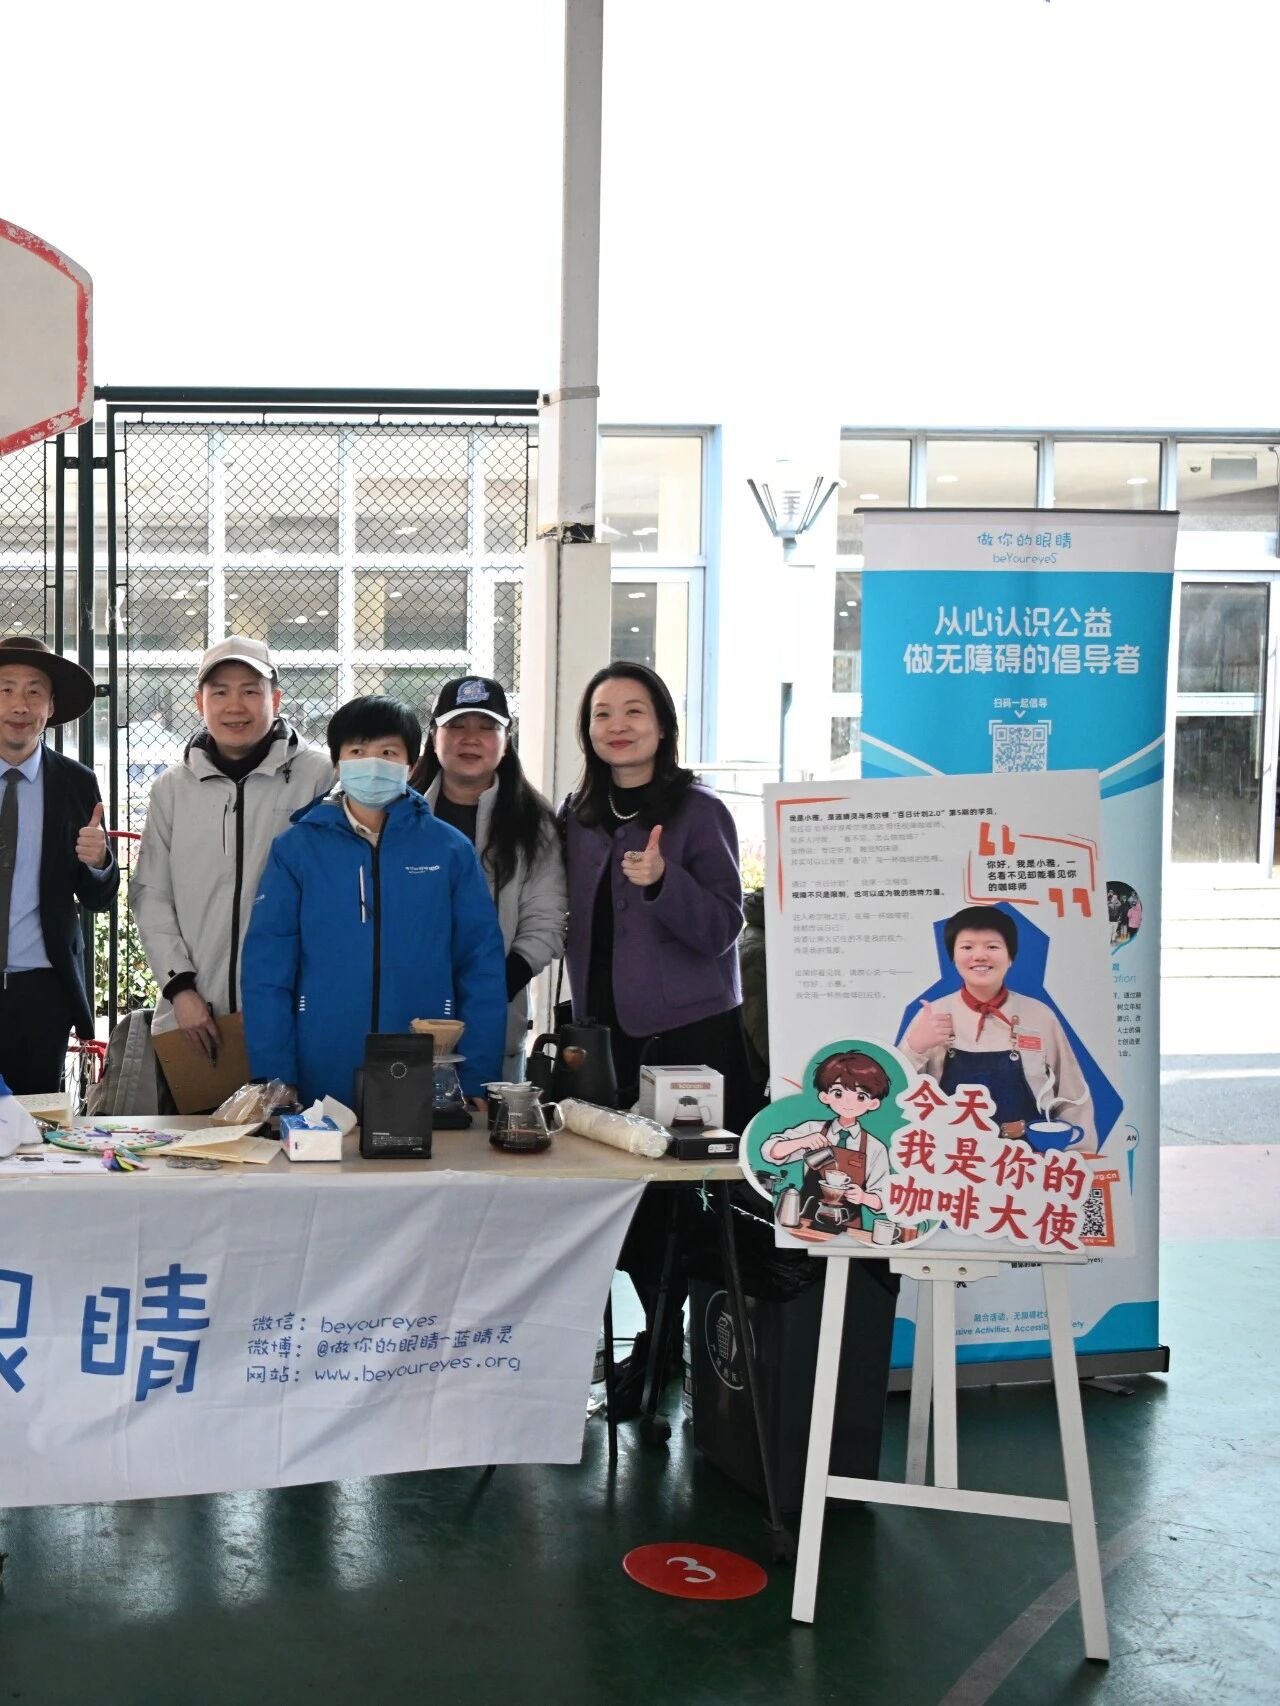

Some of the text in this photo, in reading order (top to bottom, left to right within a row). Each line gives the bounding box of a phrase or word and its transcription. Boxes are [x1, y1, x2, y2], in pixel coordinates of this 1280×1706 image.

[976, 532, 1073, 549] 做你的眼睛
[934, 606, 1113, 638] 从心认识公益
[903, 643, 1141, 675] 做无障碍的倡导者
[993, 697, 1048, 709] 扫码一起倡导
[988, 870, 1077, 880] 名看不见却能看见你
[988, 882, 1028, 892] 的咖啡师
[904, 1079, 992, 1132] 今天
[895, 1128, 1088, 1201] 我是你的
[888, 1176, 1080, 1250] 咖啡大使
[321, 1315, 438, 1334] beyoureyes
[315, 1357, 521, 1382] www.beyoureyes.org
[666, 1556, 716, 1583] 3
